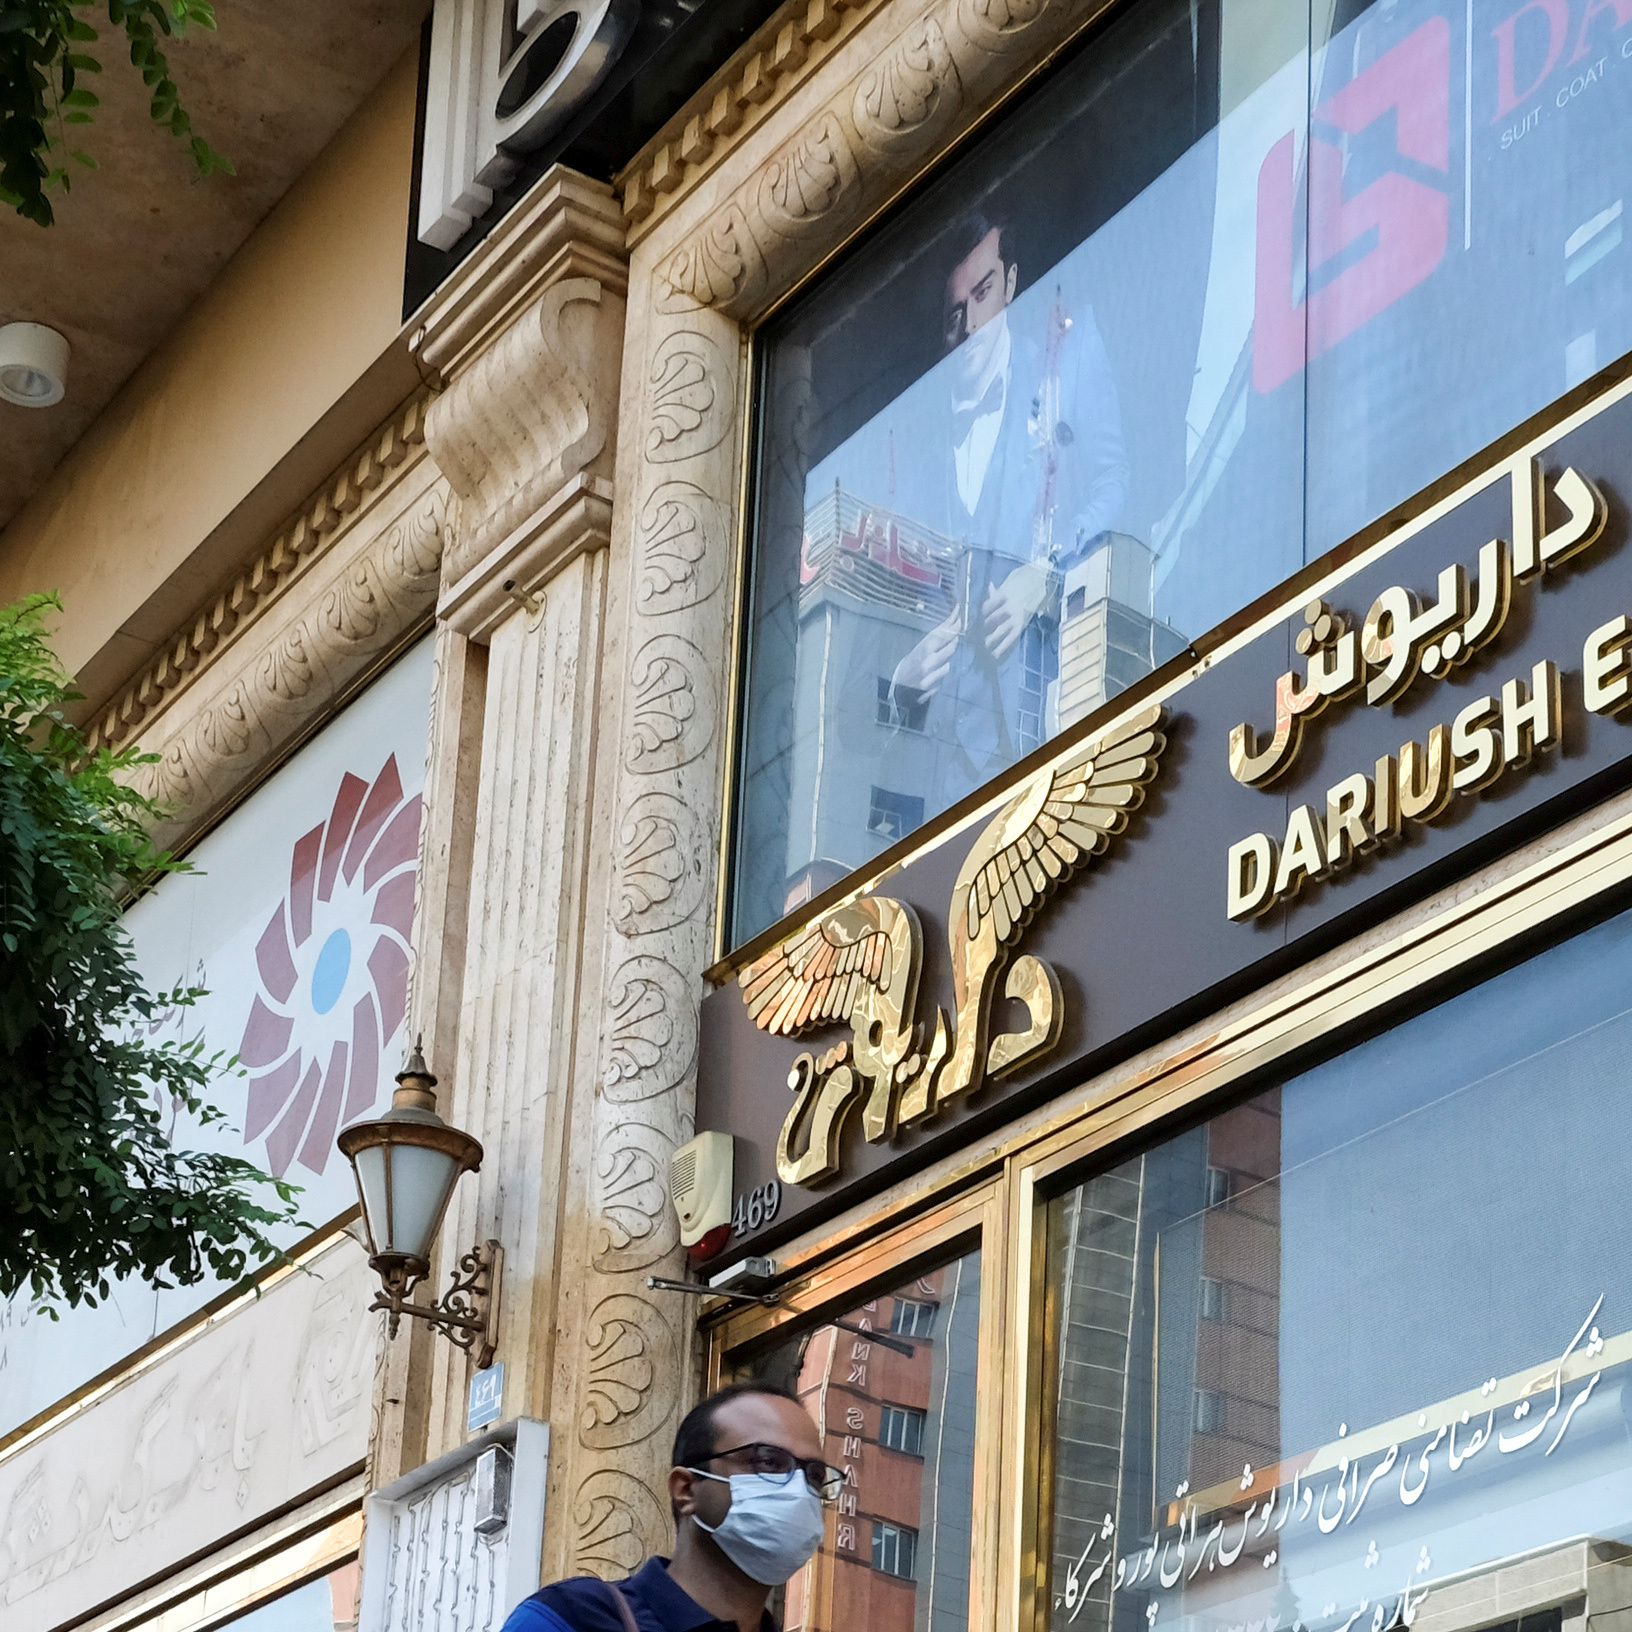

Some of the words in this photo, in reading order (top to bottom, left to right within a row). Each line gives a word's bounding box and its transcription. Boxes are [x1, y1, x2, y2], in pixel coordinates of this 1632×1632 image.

[1501, 107, 1542, 150] SUIT
[1556, 57, 1608, 108] COAT
[1228, 452, 1606, 787] داریوش
[1226, 660, 1562, 921] DARIUSH
[731, 1179, 781, 1238] 469
[1498, 1293, 1604, 1456] شرکت
[1318, 1423, 1399, 1534] صرافی
[1400, 1377, 1497, 1505] تضامنی
[1218, 1463, 1313, 1568] داریوش
